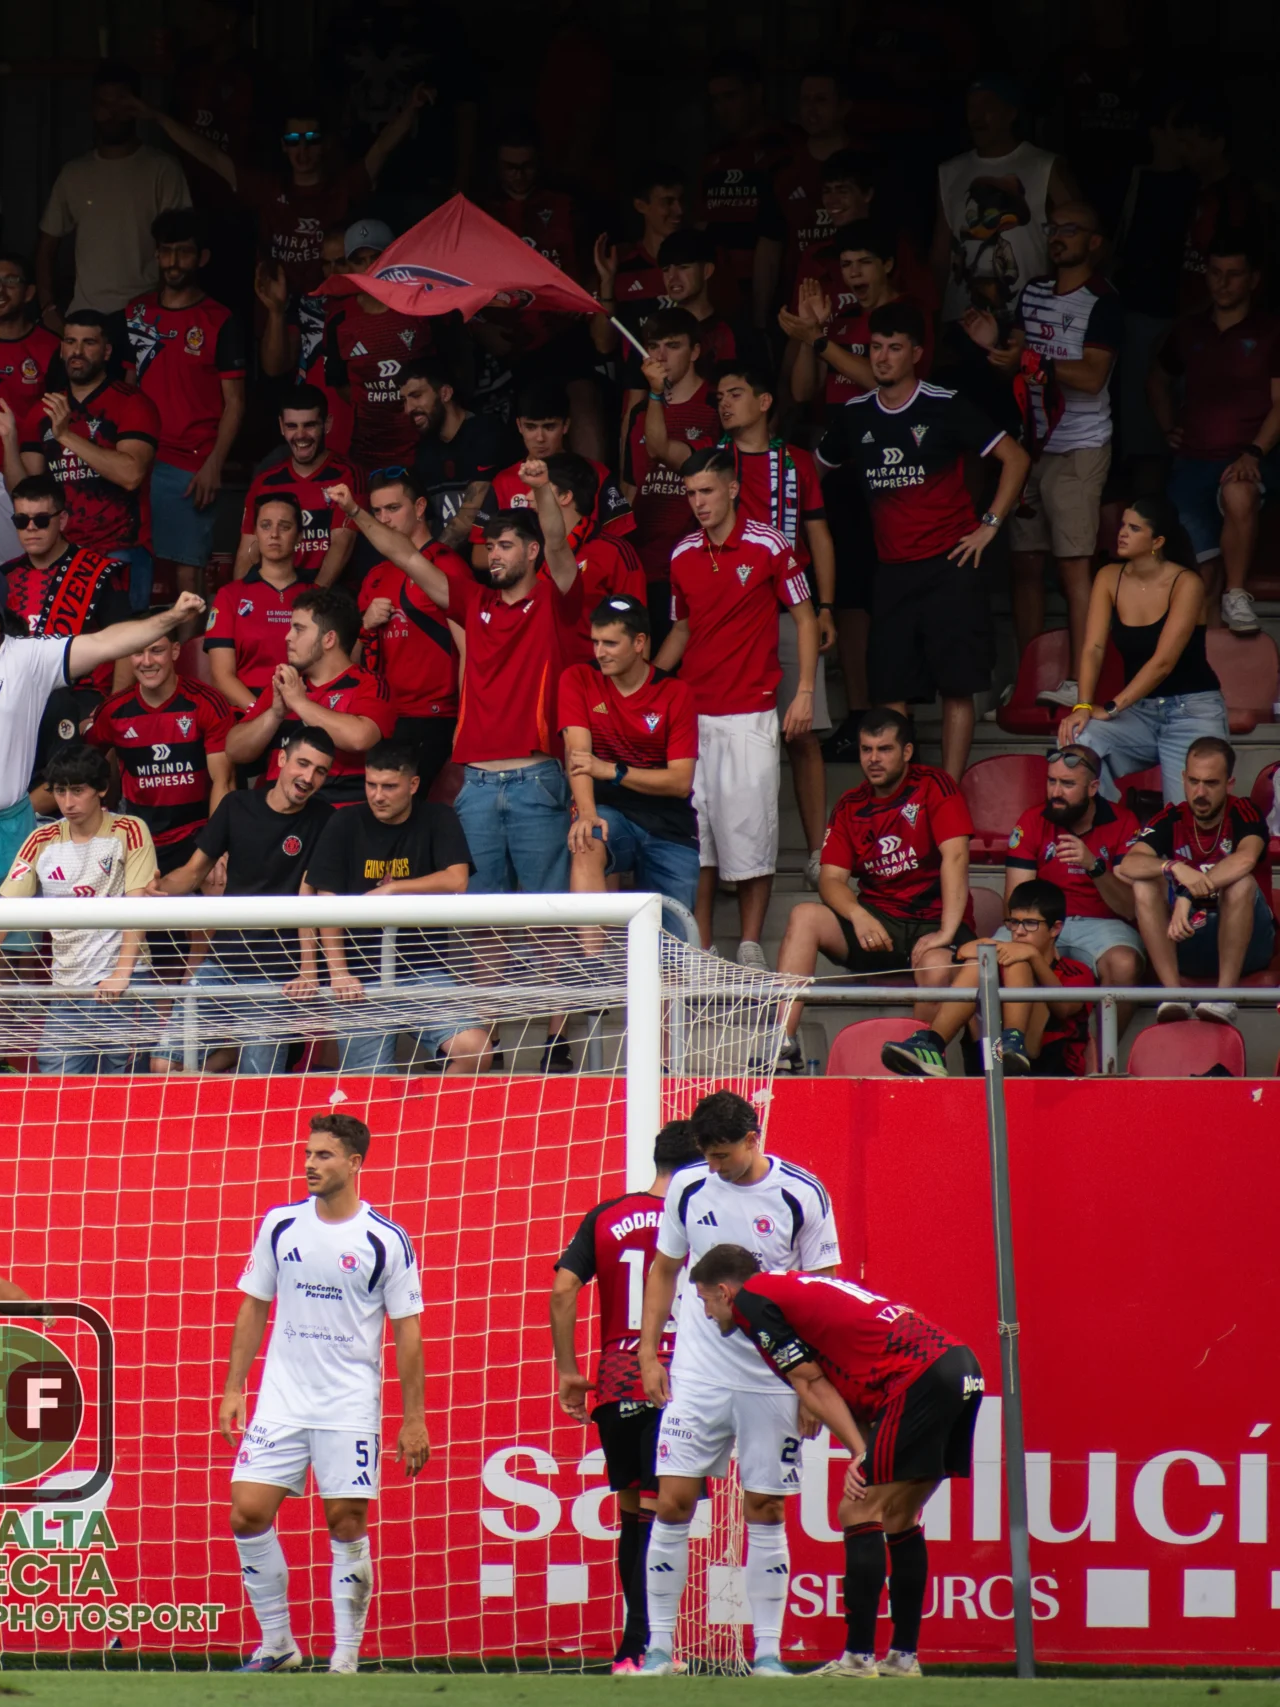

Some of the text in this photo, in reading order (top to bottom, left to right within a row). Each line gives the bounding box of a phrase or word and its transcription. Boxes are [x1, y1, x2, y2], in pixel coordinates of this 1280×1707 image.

[797, 227, 837, 241] MIRAN
[866, 466, 926, 479] MIRANDA
[364, 859, 386, 879] GUNS
[296, 1281, 343, 1294] BricoCentro
[333, 1333, 355, 1344] salud
[355, 1440, 370, 1468] 5
